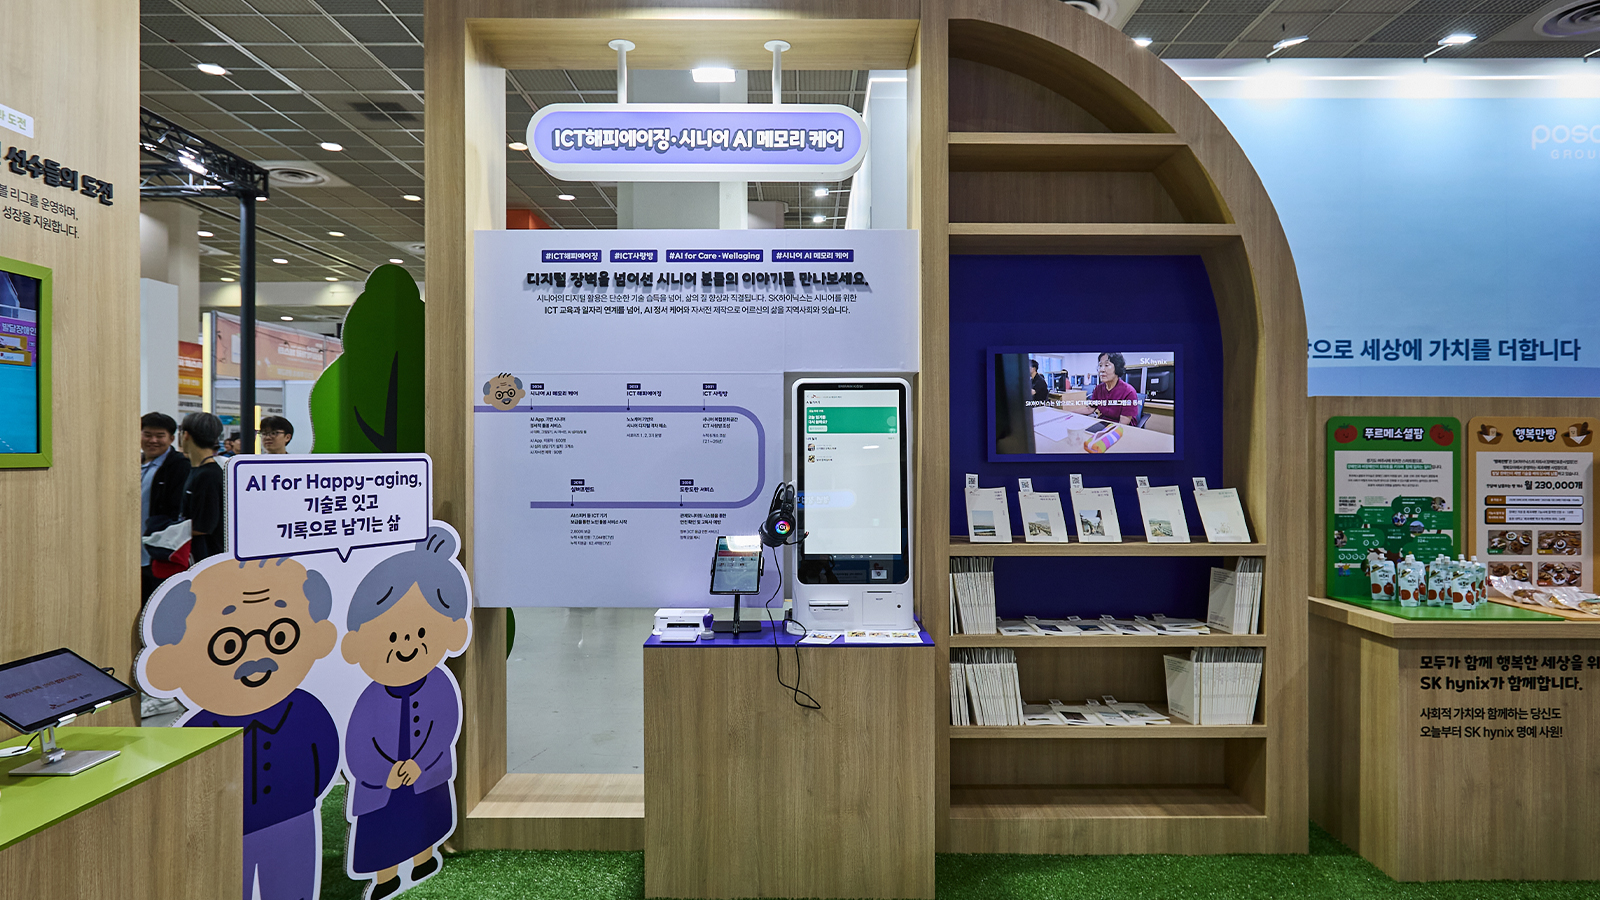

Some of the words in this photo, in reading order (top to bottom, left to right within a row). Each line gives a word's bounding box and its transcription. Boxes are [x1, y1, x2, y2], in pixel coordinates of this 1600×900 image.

[8, 112, 26, 131] 도전
[733, 131, 752, 147] AI
[757, 131, 805, 147] 메모리
[810, 131, 842, 147] 케어
[1551, 149, 1600, 159] GROU
[3, 146, 79, 191] 선수들의
[80, 174, 114, 207] 도전
[10, 187, 39, 209] 리그를
[41, 197, 79, 221] 운영하며,
[2, 205, 31, 226] 성장을
[33, 214, 80, 239] 지원합니다.
[546, 252, 598, 261] #ICT해피에이징
[614, 252, 654, 261] #ICT사랑방
[669, 252, 683, 260] #AI
[685, 252, 697, 260] for
[698, 252, 717, 260] Care
[722, 252, 760, 262] Wellaging
[776, 252, 802, 260] #시니어
[804, 252, 811, 260] AI
[814, 252, 833, 260] 메모리
[835, 252, 849, 260] 케어
[527, 272, 566, 287] 디지털
[571, 271, 609, 288] 장벽을
[614, 272, 653, 287] 넘어선
[657, 273, 696, 285] 시니어
[701, 272, 738, 287] 분들의
[742, 272, 795, 287] 이야기를
[799, 272, 868, 286] 만나보세요.
[1361, 339, 1422, 361] 세상에
[1429, 339, 1491, 361] 가치를
[1499, 339, 1581, 361] 더합니다
[1365, 428, 1424, 440] 푸르메소셜팜
[1515, 428, 1557, 441] 행복만빵
[245, 475, 266, 491] AI
[271, 474, 302, 490] for
[306, 471, 422, 492] Happy-aging,
[1524, 480, 1533, 490] 월
[1535, 480, 1583, 490] 230,000개
[304, 495, 348, 514] 기술로
[352, 494, 378, 512] 잇고
[277, 519, 338, 539] 기록으로
[342, 516, 383, 536] 남기는
[387, 514, 401, 532] 삶
[1420, 656, 1461, 669] 모두가
[1464, 655, 1492, 670] 함께
[1496, 655, 1538, 671] 행복한
[1541, 655, 1583, 671] 세상을
[1587, 656, 1600, 669] 위
[1421, 677, 1441, 689] SK
[1446, 676, 1505, 692] hynix가
[1507, 675, 1583, 691] 함께합니다.
[1420, 708, 1451, 719] 사회적
[1454, 708, 1485, 720] 가치와
[1488, 708, 1528, 720] 함께하는
[1531, 708, 1562, 720] 당신도
[1420, 726, 1461, 738] 오늘부터
[1465, 727, 1481, 737] SK
[1484, 727, 1514, 740] hynix
[1517, 726, 1537, 738] 명예
[1539, 726, 1562, 738] 사원!
